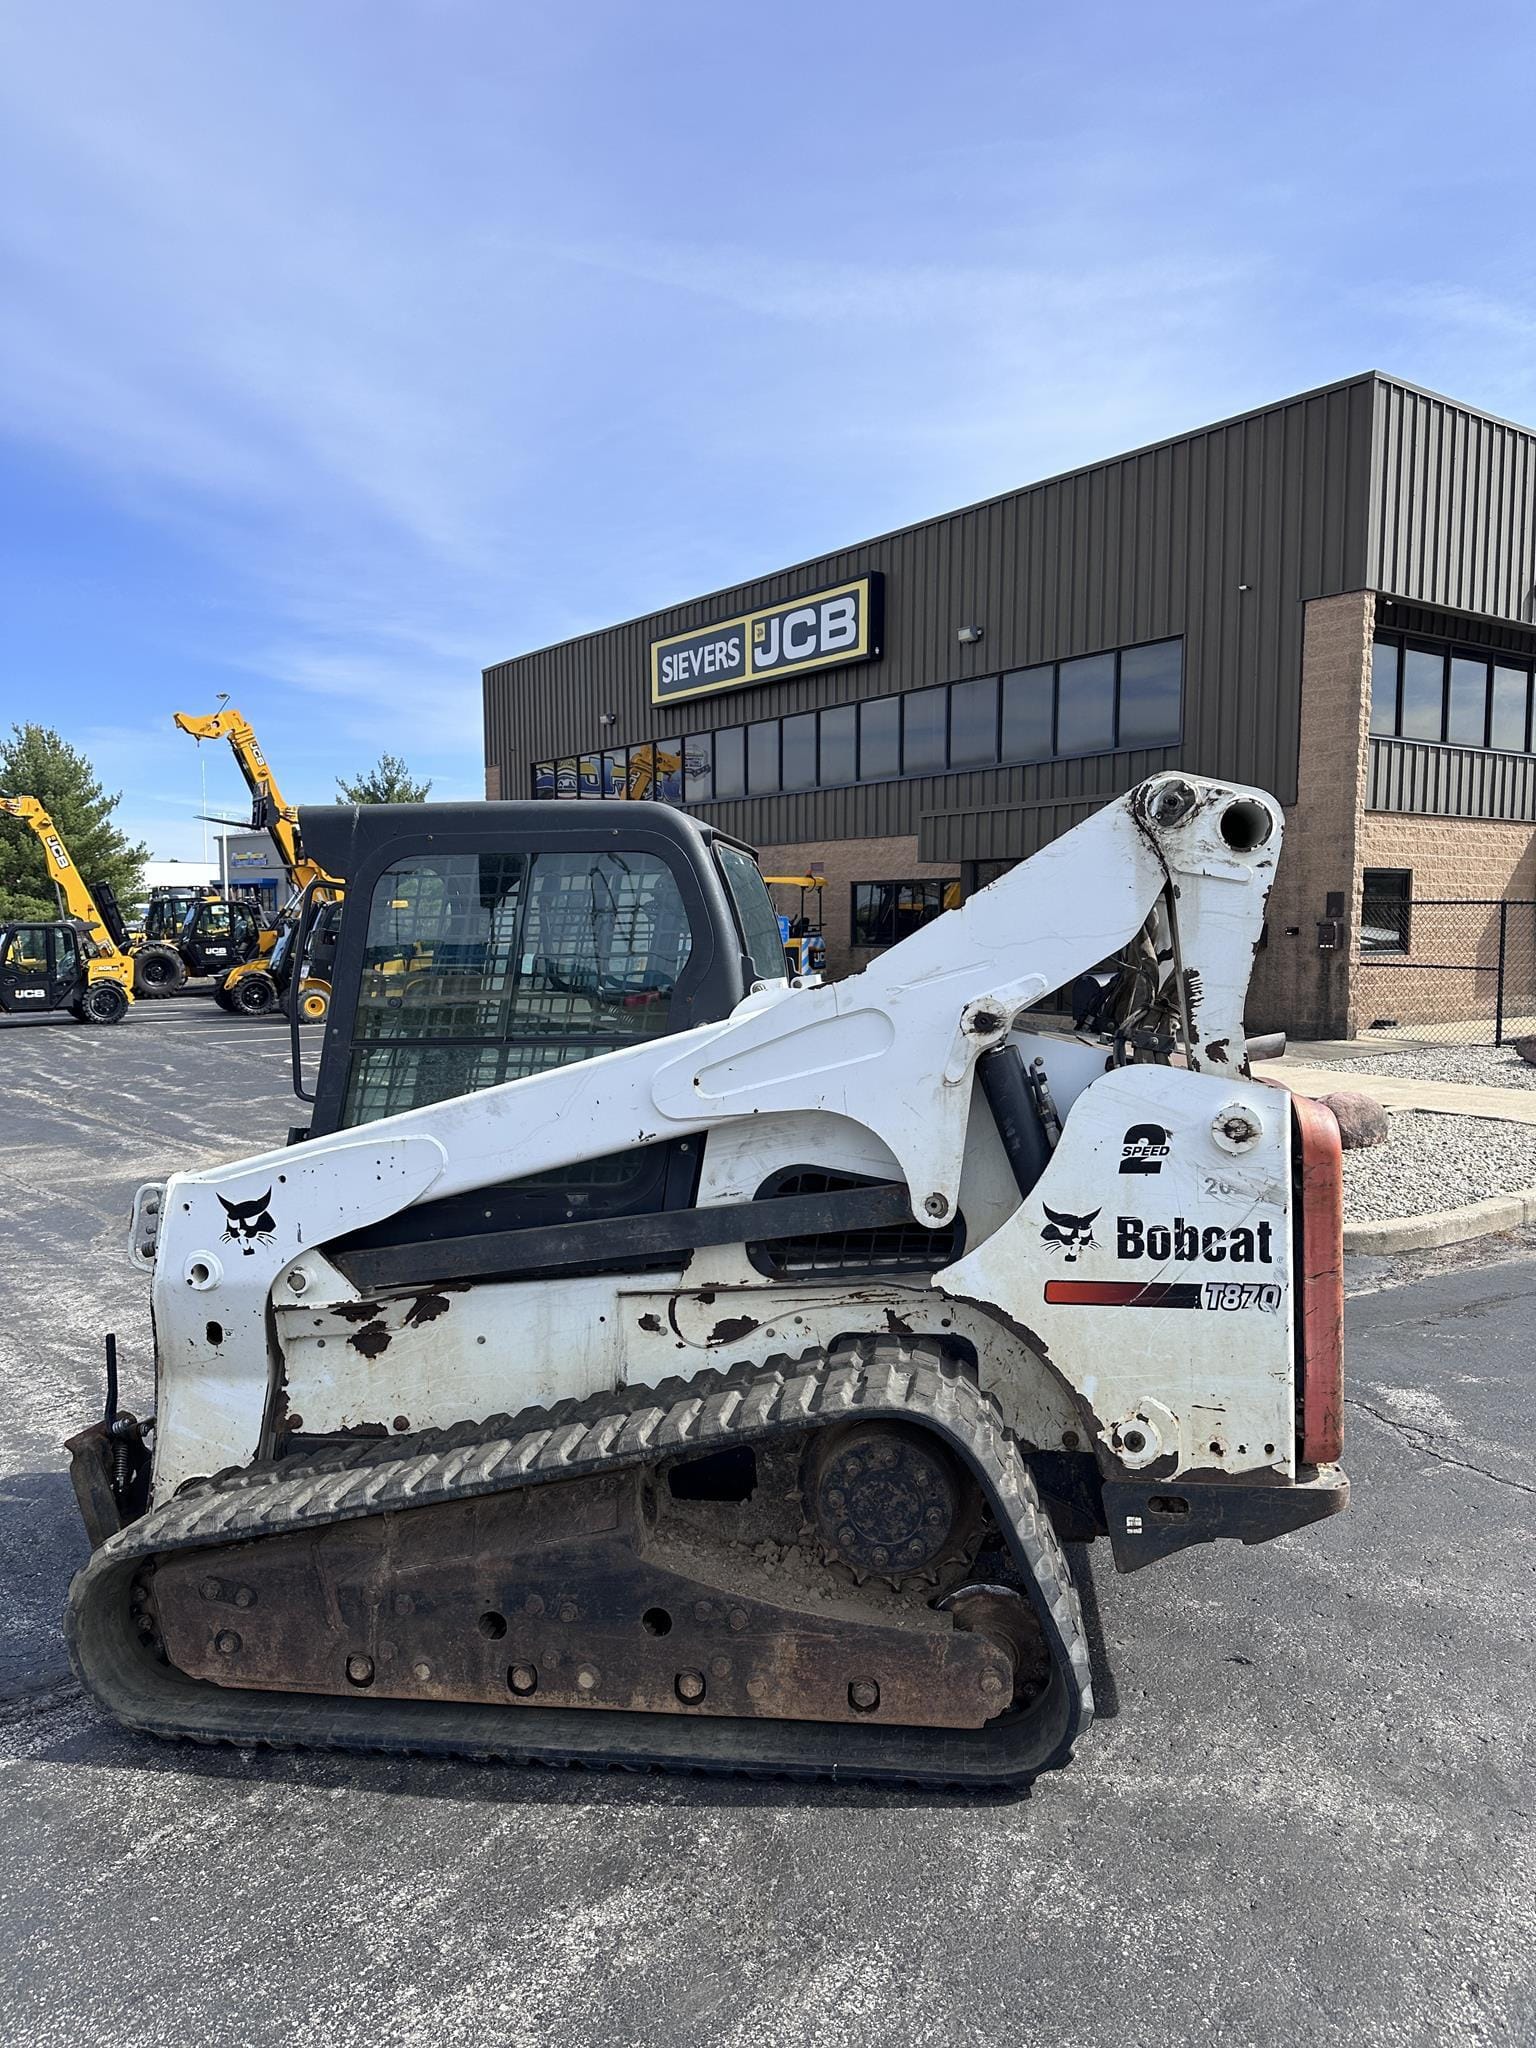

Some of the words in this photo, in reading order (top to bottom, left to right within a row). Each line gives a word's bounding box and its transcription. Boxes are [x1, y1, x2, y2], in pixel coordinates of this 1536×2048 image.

[661, 637, 740, 684] SIEVERS
[754, 597, 857, 667] JCB
[249, 742, 265, 767] JCB
[45, 835, 70, 869] JCB
[205, 947, 227, 955] JCB
[14, 989, 46, 999] JCB
[1118, 1123, 1167, 1175] 2
[1121, 1146, 1170, 1157] SPEED
[1117, 1216, 1272, 1264] Bobcat
[1205, 1282, 1282, 1313] T870
